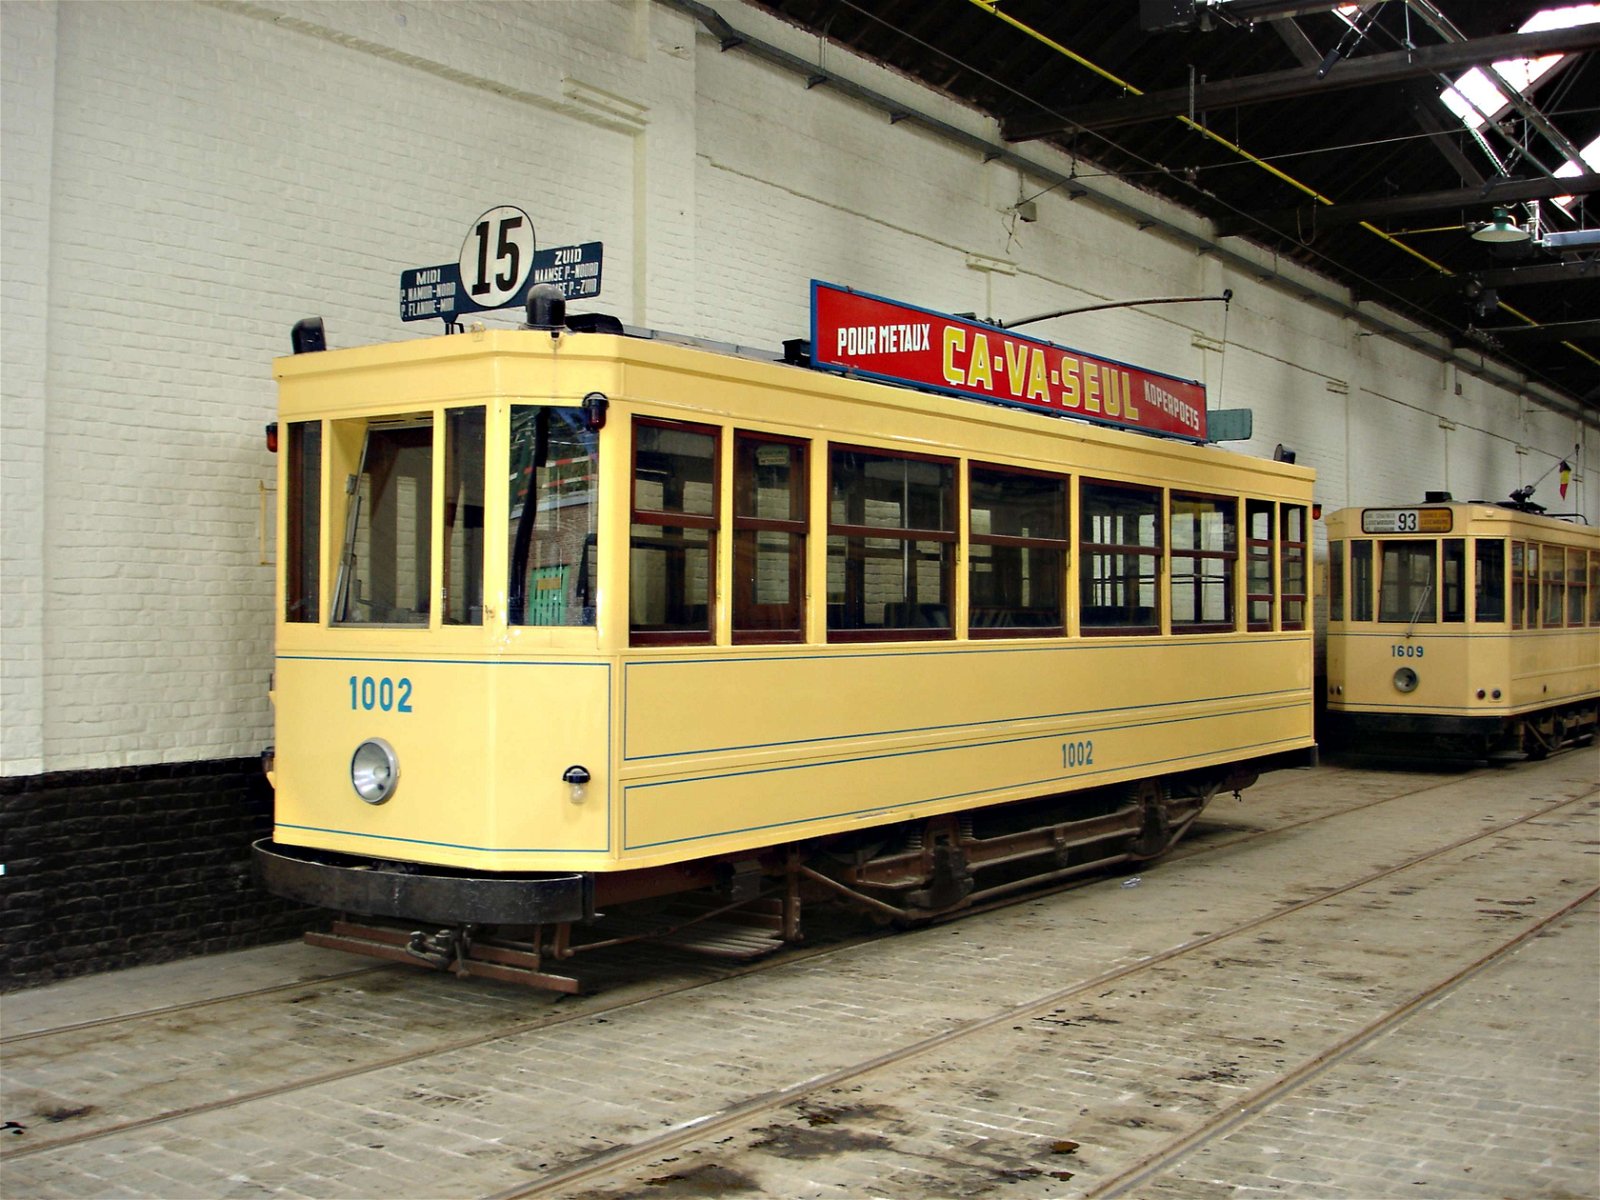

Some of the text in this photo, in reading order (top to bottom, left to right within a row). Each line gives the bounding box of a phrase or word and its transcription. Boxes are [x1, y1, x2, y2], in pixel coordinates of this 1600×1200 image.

[472, 216, 523, 295] 15
[554, 248, 582, 265] ZUID
[416, 268, 441, 285] MIDI
[837, 323, 930, 357] POUR METAUX
[1144, 379, 1199, 431] KOPERPOETS
[1398, 512, 1417, 531] 93
[1391, 645, 1424, 658] 1609
[349, 675, 413, 713] 1002
[1062, 740, 1093, 769] 1002
